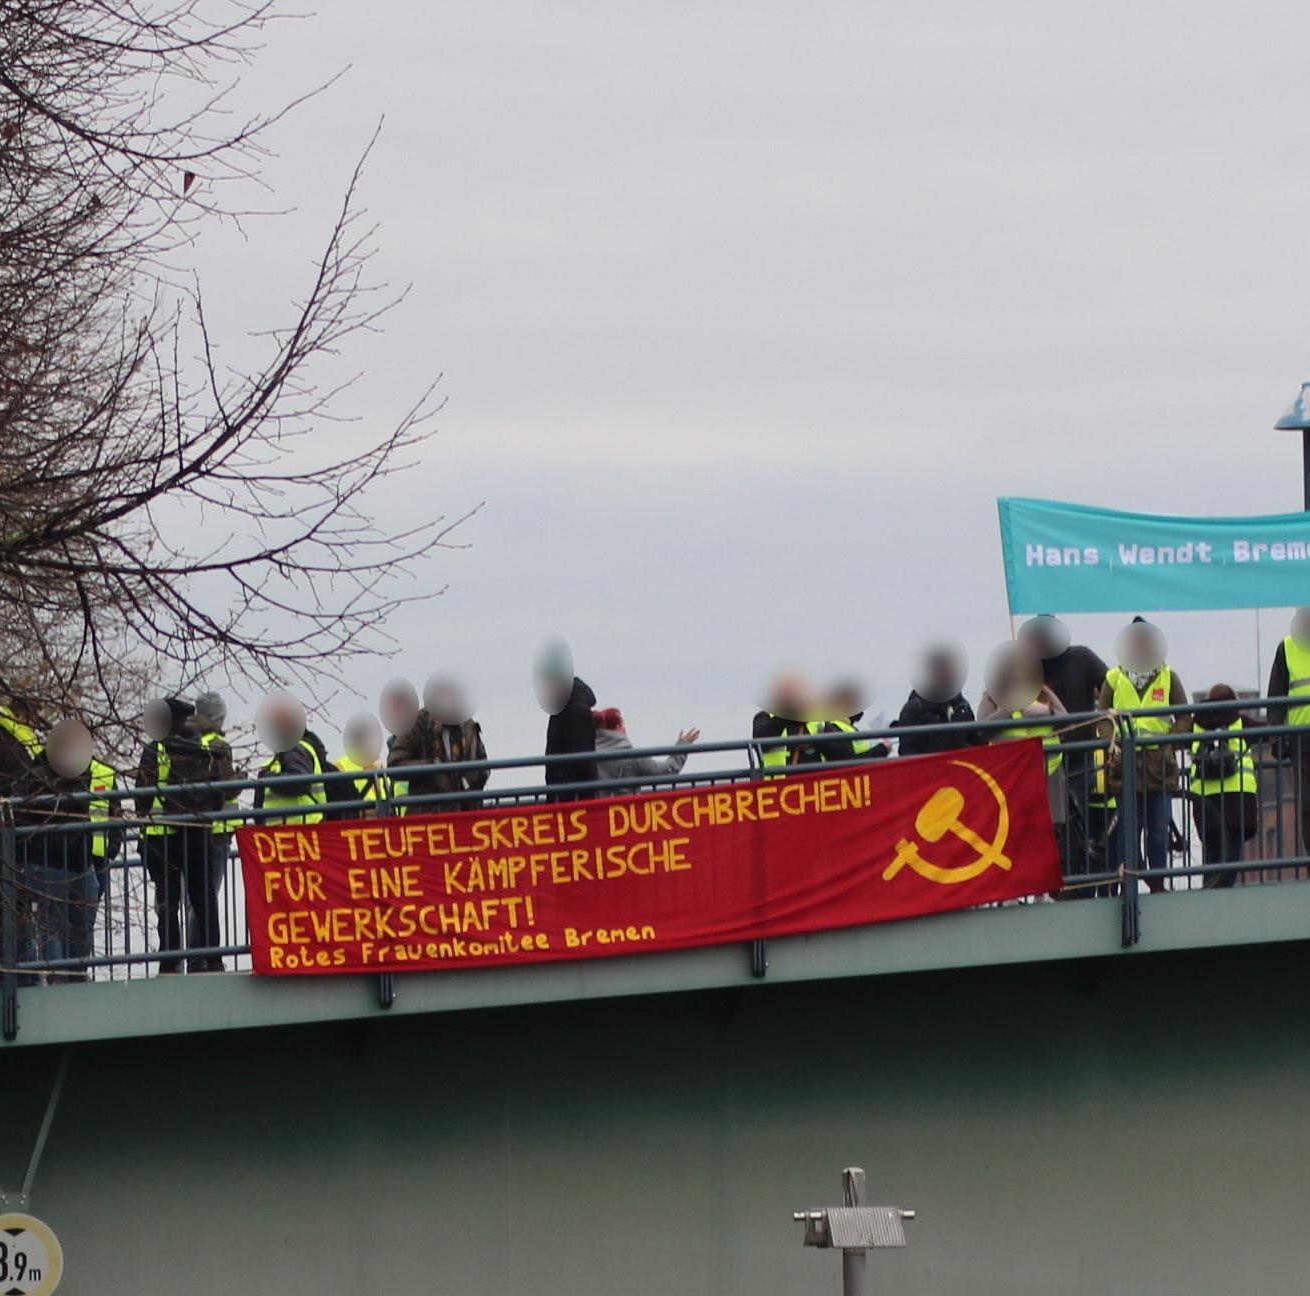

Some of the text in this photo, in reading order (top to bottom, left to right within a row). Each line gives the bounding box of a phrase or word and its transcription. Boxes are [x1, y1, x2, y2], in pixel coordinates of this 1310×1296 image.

[1025, 543, 1100, 567] Hans
[1118, 541, 1213, 566] Wendt
[254, 775, 871, 864] DEN TEUFELSKREIS DURCHBRECHEN!
[263, 837, 692, 903] FÜR EINE KÄMPFERISCHE
[267, 896, 535, 945] GEWERKSCHAFT!
[270, 925, 657, 969] Rotes Frauenkomitee Bremen
